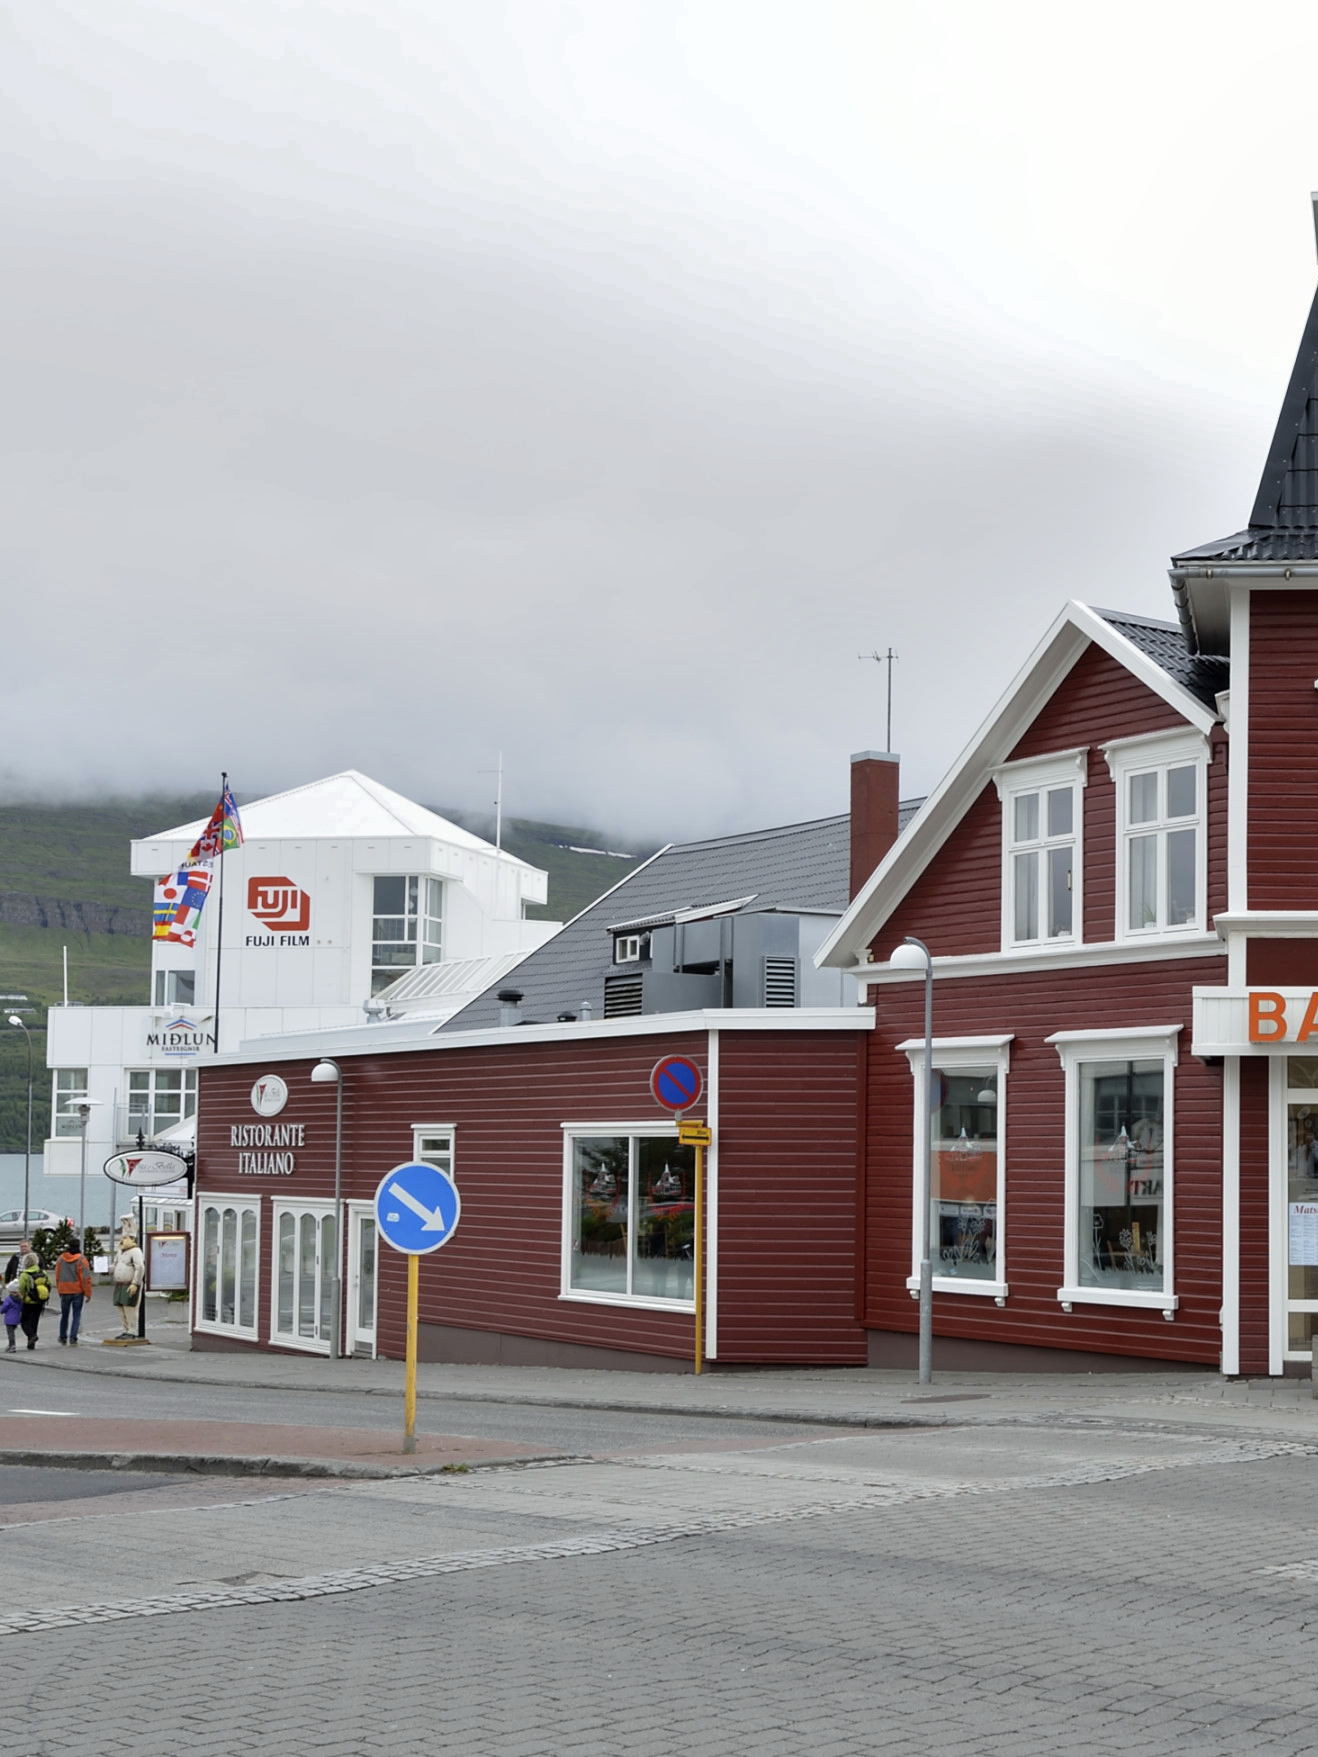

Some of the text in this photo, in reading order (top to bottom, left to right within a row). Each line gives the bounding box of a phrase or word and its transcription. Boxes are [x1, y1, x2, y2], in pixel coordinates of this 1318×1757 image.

[248, 884, 303, 922] FUJI
[246, 935, 310, 947] FUJI FILM
[231, 1124, 305, 1147] RISTORANTE
[239, 1152, 294, 1175] ITALIANO
